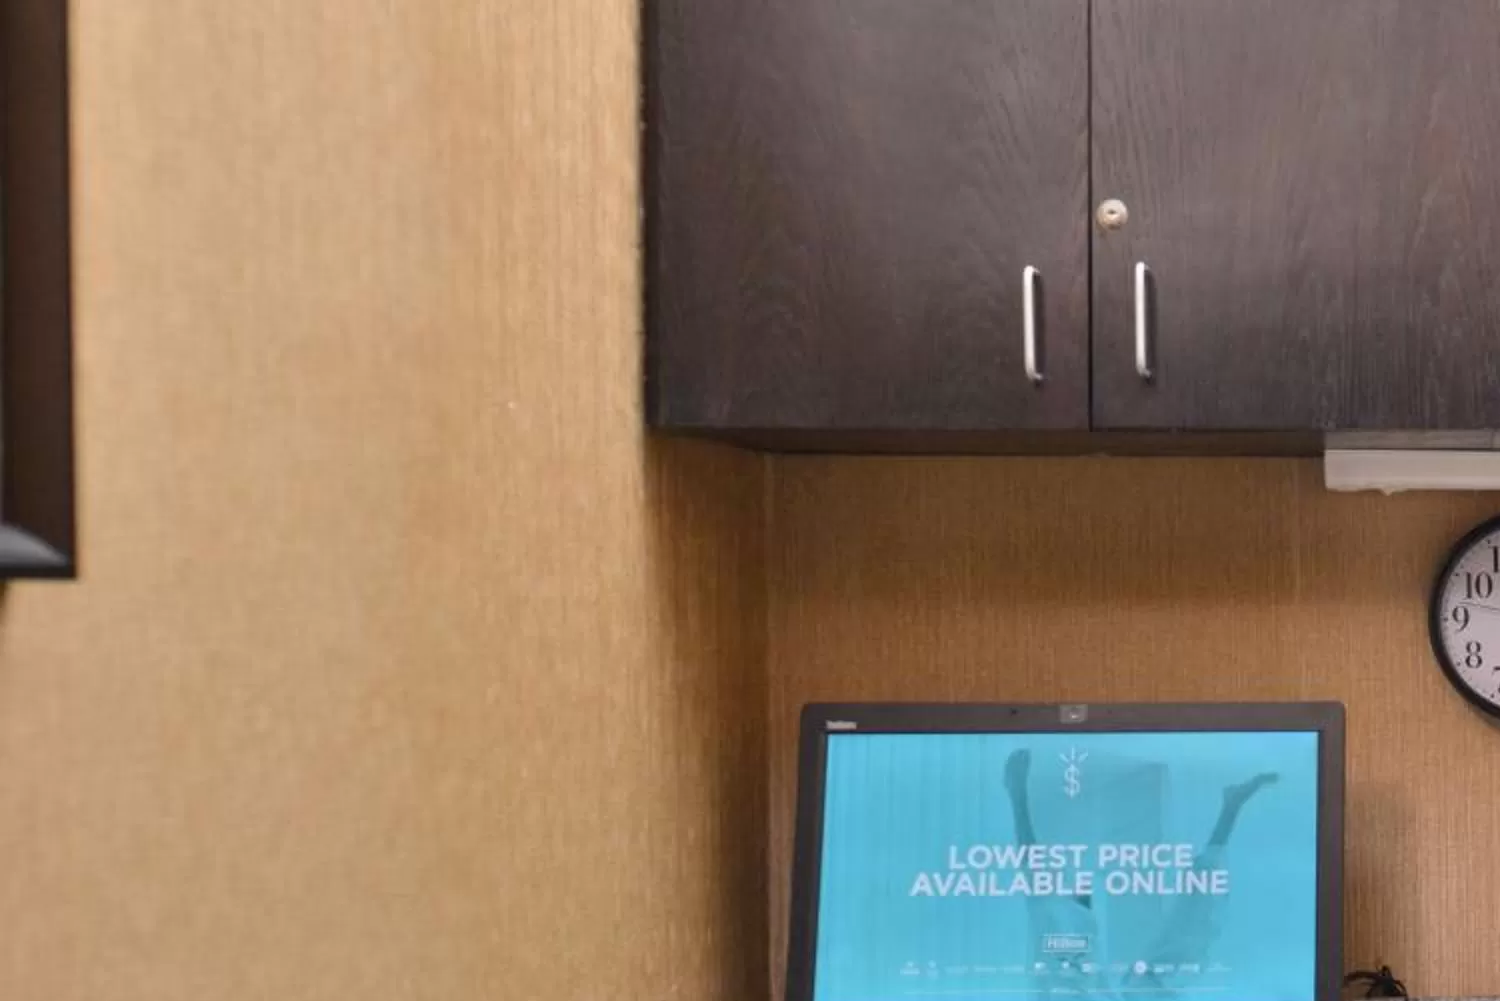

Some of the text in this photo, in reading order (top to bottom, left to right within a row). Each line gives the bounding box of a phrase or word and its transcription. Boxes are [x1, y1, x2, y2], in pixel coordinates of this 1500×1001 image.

[1464, 571, 1493, 599] 10
[1452, 605, 1470, 632] 9
[1465, 641, 1482, 669] 8
[949, 843, 1194, 869] LOWEST PRICE
[910, 869, 1229, 897] AVAILABLE ONLINE
